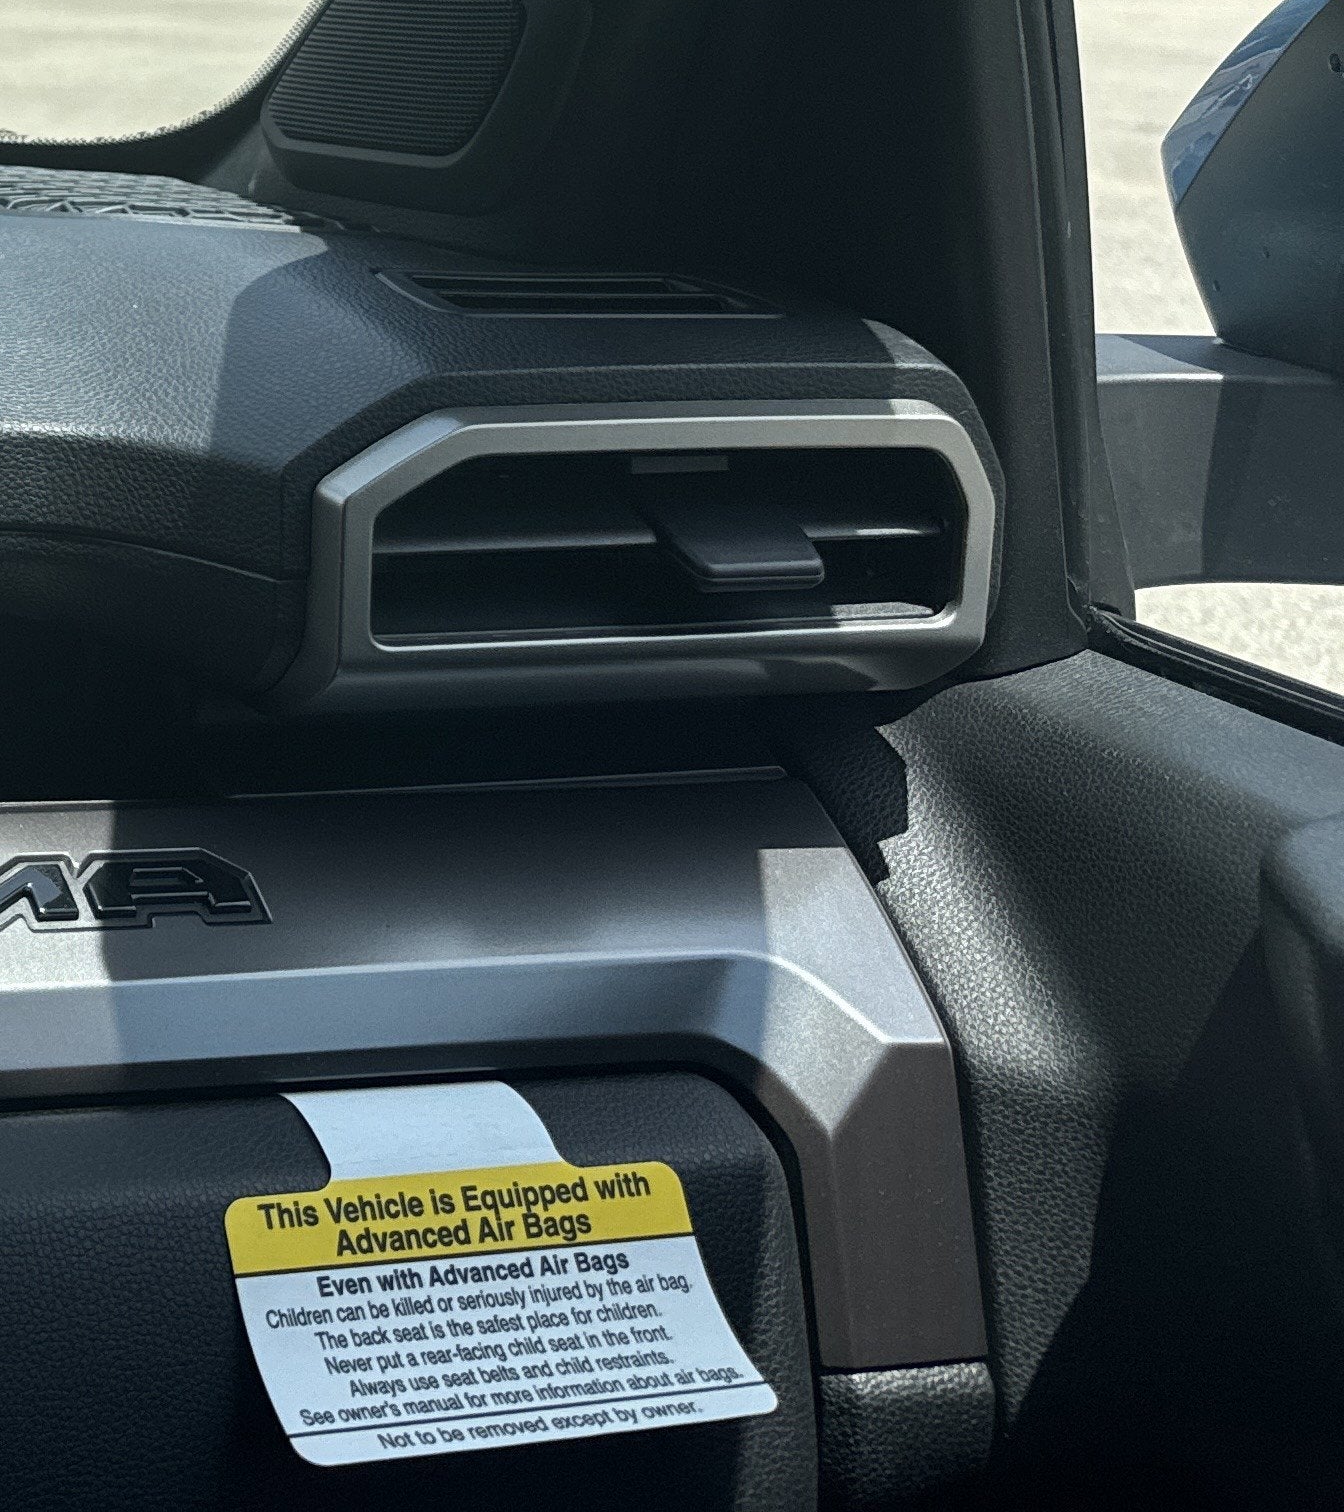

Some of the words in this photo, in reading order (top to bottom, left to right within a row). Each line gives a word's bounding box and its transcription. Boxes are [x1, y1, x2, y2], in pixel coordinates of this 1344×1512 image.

[257, 1201, 319, 1230] This
[324, 1192, 425, 1224] Vehicle
[429, 1188, 456, 1215] is
[461, 1176, 589, 1217] Equipped
[594, 1171, 651, 1200] with
[336, 1218, 472, 1257] Advanced
[478, 1215, 515, 1243] Air
[522, 1212, 592, 1241] Bags
[316, 1275, 370, 1298] Even
[376, 1268, 423, 1292] with
[429, 1257, 534, 1287] Advanced
[539, 1253, 569, 1277] Air
[573, 1251, 630, 1275] Bags
[265, 1307, 333, 1330] Children
[336, 1305, 366, 1322] can
[368, 1300, 390, 1319] be
[392, 1295, 434, 1317] killed
[437, 1295, 453, 1313] or
[457, 1287, 526, 1311] seriously
[529, 1281, 583, 1307] injured
[583, 1280, 604, 1301] by
[606, 1277, 632, 1296] the
[636, 1276, 655, 1293] air
[658, 1274, 693, 1294] bag.
[314, 1331, 349, 1350] The
[349, 1326, 392, 1348] back
[392, 1322, 427, 1344] seat
[428, 1321, 446, 1339] is
[446, 1317, 474, 1337] the
[476, 1313, 525, 1335] safest
[526, 1310, 570, 1334] place
[571, 1306, 594, 1325] for
[596, 1302, 662, 1323] children.
[324, 1355, 373, 1375] Never
[376, 1352, 405, 1374] put
[406, 1351, 419, 1367] a
[420, 1341, 508, 1365] rear-facing
[507, 1338, 546, 1357] child
[550, 1334, 583, 1353] seat
[583, 1330, 602, 1349] in
[602, 1328, 629, 1348] the
[630, 1325, 673, 1344] front.
[349, 1377, 407, 1398] Always
[408, 1374, 440, 1391] use
[442, 1368, 478, 1388] seat
[478, 1364, 520, 1385] belts
[521, 1360, 553, 1380] and
[554, 1356, 595, 1376] child
[595, 1349, 674, 1372] restraints.
[299, 1409, 336, 1427] See
[338, 1400, 402, 1422] owner's
[403, 1394, 464, 1416] manual
[464, 1391, 488, 1408] for
[490, 1388, 534, 1407] more
[533, 1378, 625, 1402] information
[626, 1372, 675, 1391] about
[674, 1369, 694, 1386] air
[696, 1366, 744, 1384] bags.
[376, 1431, 416, 1449] Not
[416, 1428, 437, 1445] to
[437, 1425, 466, 1443] be
[467, 1416, 549, 1440] removed
[551, 1409, 614, 1429] except
[613, 1405, 638, 1424] by
[641, 1400, 704, 1420] owner.
